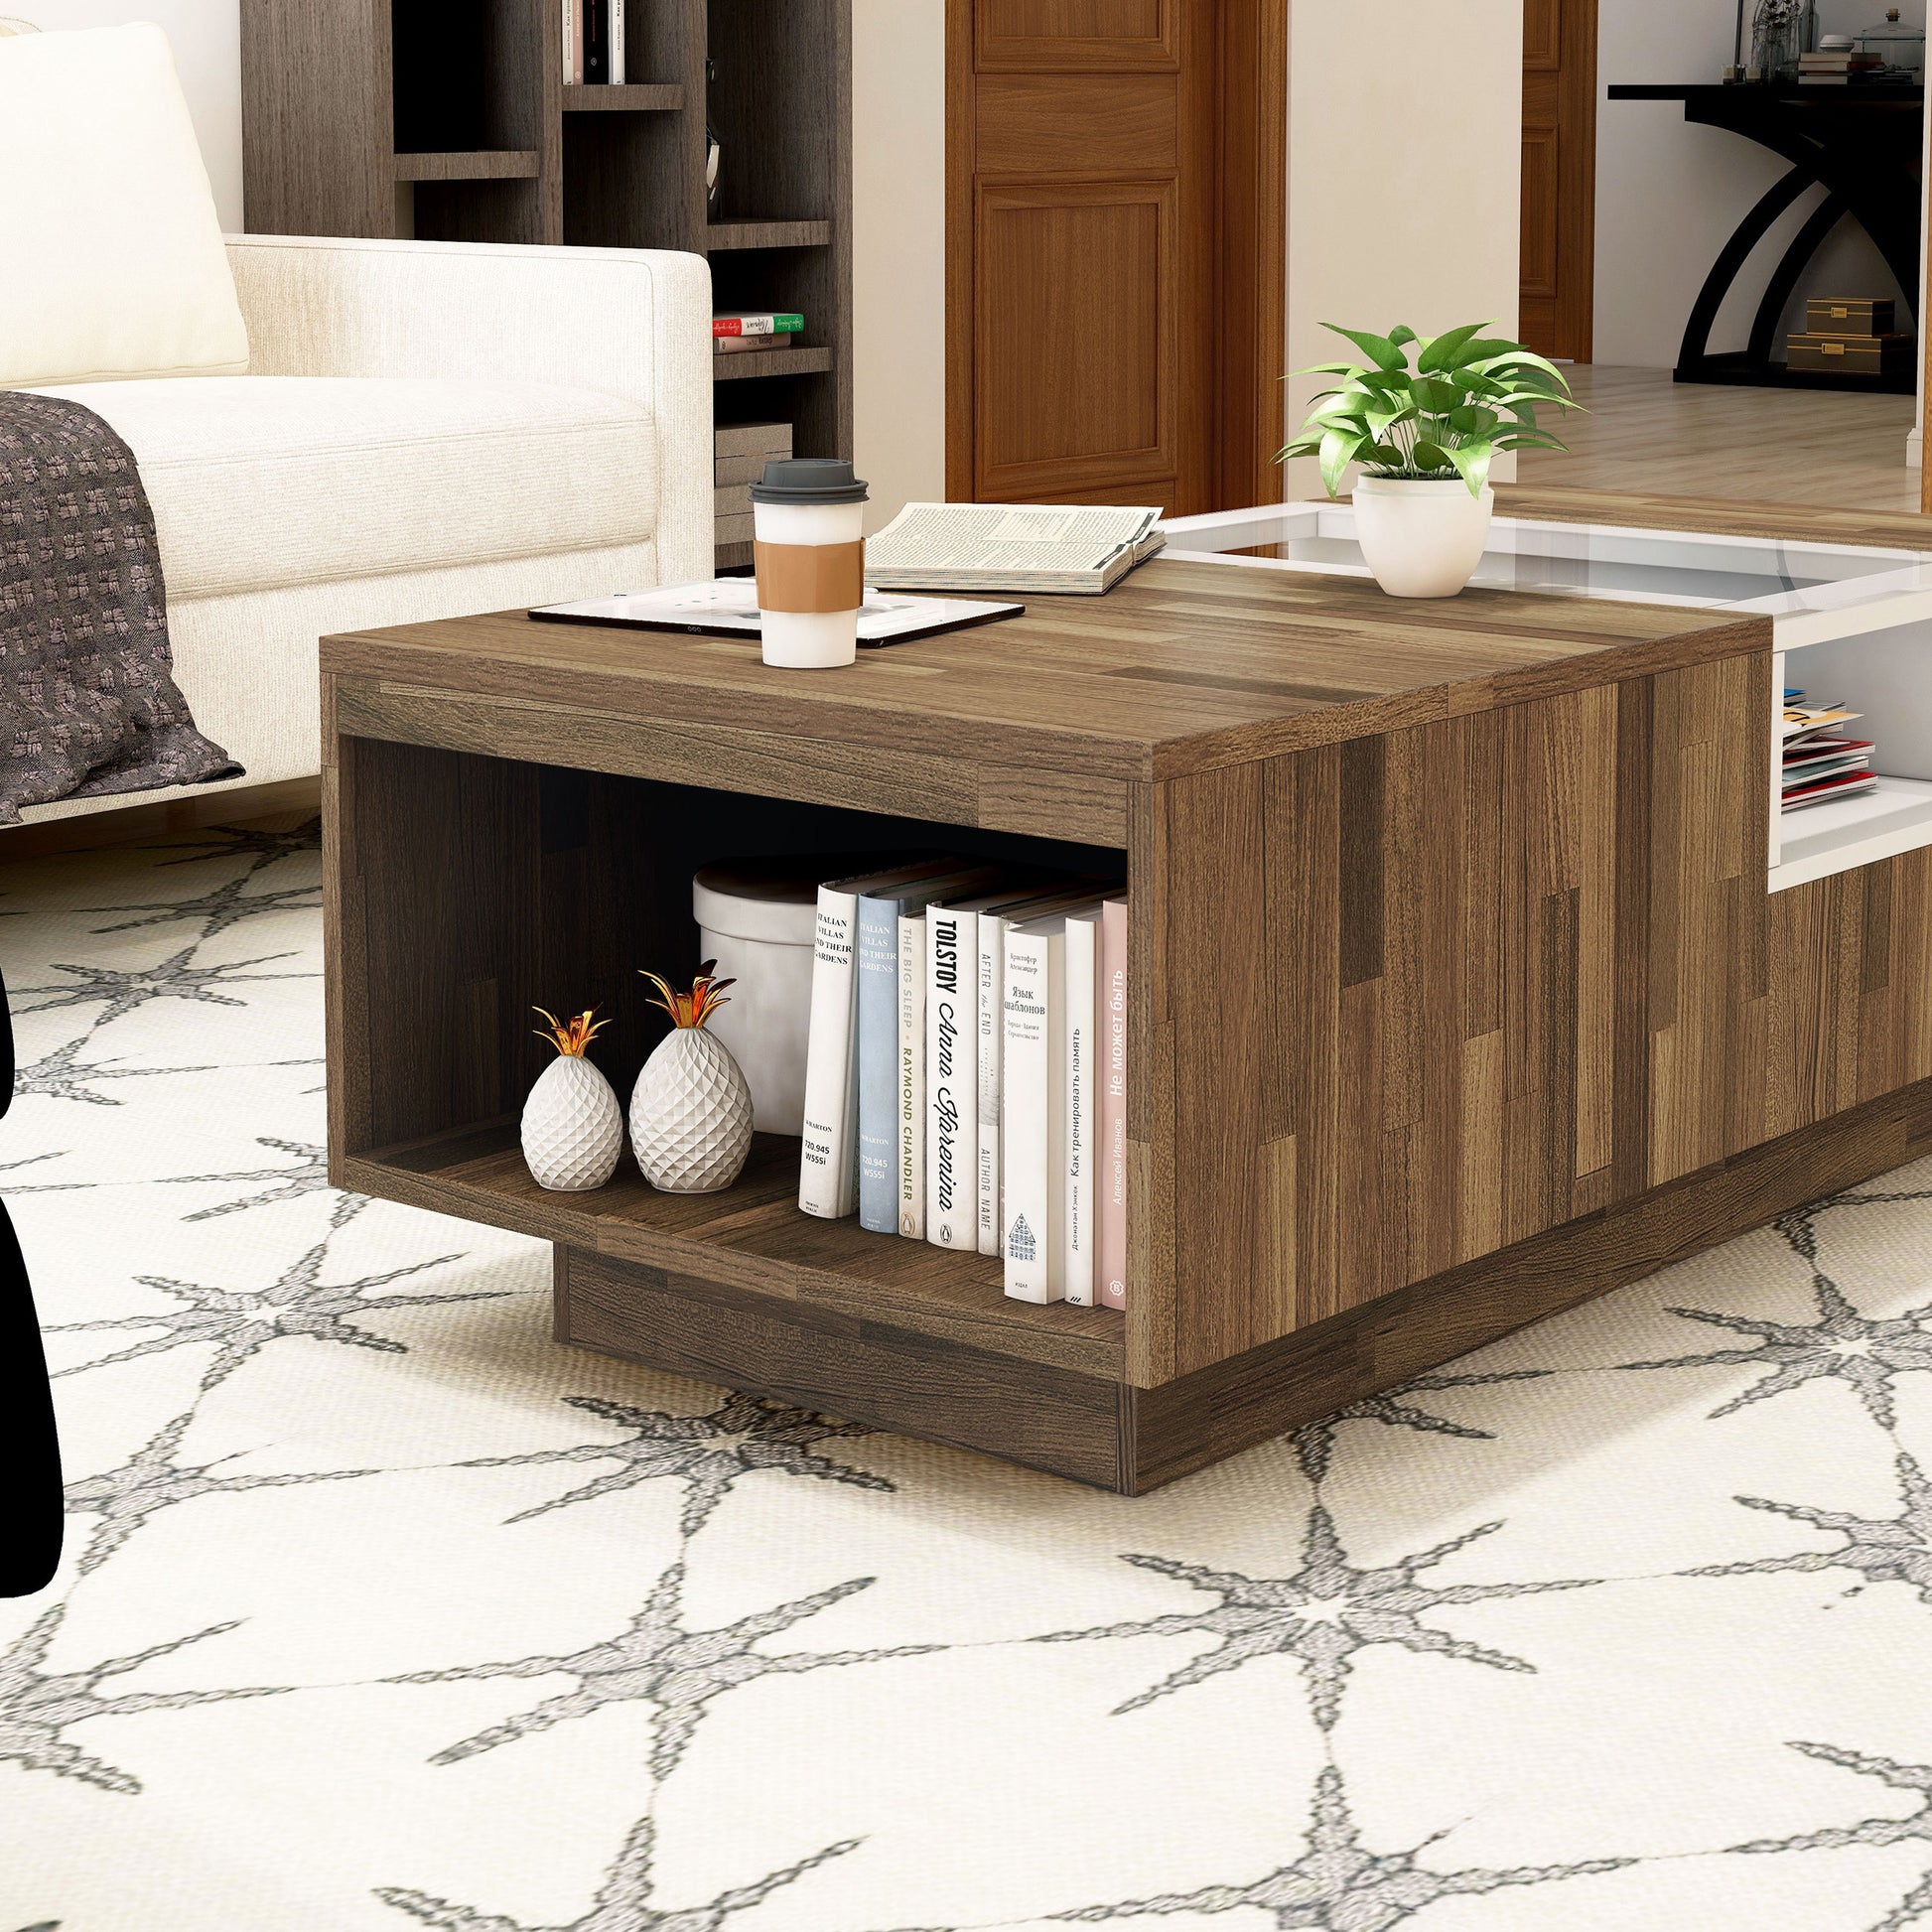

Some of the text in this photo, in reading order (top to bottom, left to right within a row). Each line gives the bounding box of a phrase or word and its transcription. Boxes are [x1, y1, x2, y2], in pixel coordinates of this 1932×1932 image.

[817, 912, 848, 927] ITALIAN
[818, 926, 844, 939] VILLAS
[860, 922, 891, 934] ITALIAN
[814, 937, 852, 953] ND THEIR
[861, 936, 889, 947] VILLAS
[870, 951, 897, 960] THEIR
[981, 953, 992, 988] AFTER
[1012, 986, 1034, 1000] Язык
[1004, 1000, 1045, 1015] шаблонов
[981, 1012, 992, 1035] END
[1109, 969, 1124, 1097] Не может быть
[902, 927, 912, 1201] THE BIG SLEEP RAYMOND CHANDLER
[933, 920, 959, 1212] TOLSTOY Anna Karenina
[1070, 1028, 1082, 1177] Как тренировать память
[804, 1140, 830, 1155] 720.945
[862, 1155, 888, 1169] 720.945
[1112, 1118, 1123, 1206] Алексей Иванов
[981, 1148, 991, 1230] AUTHOR NAME
